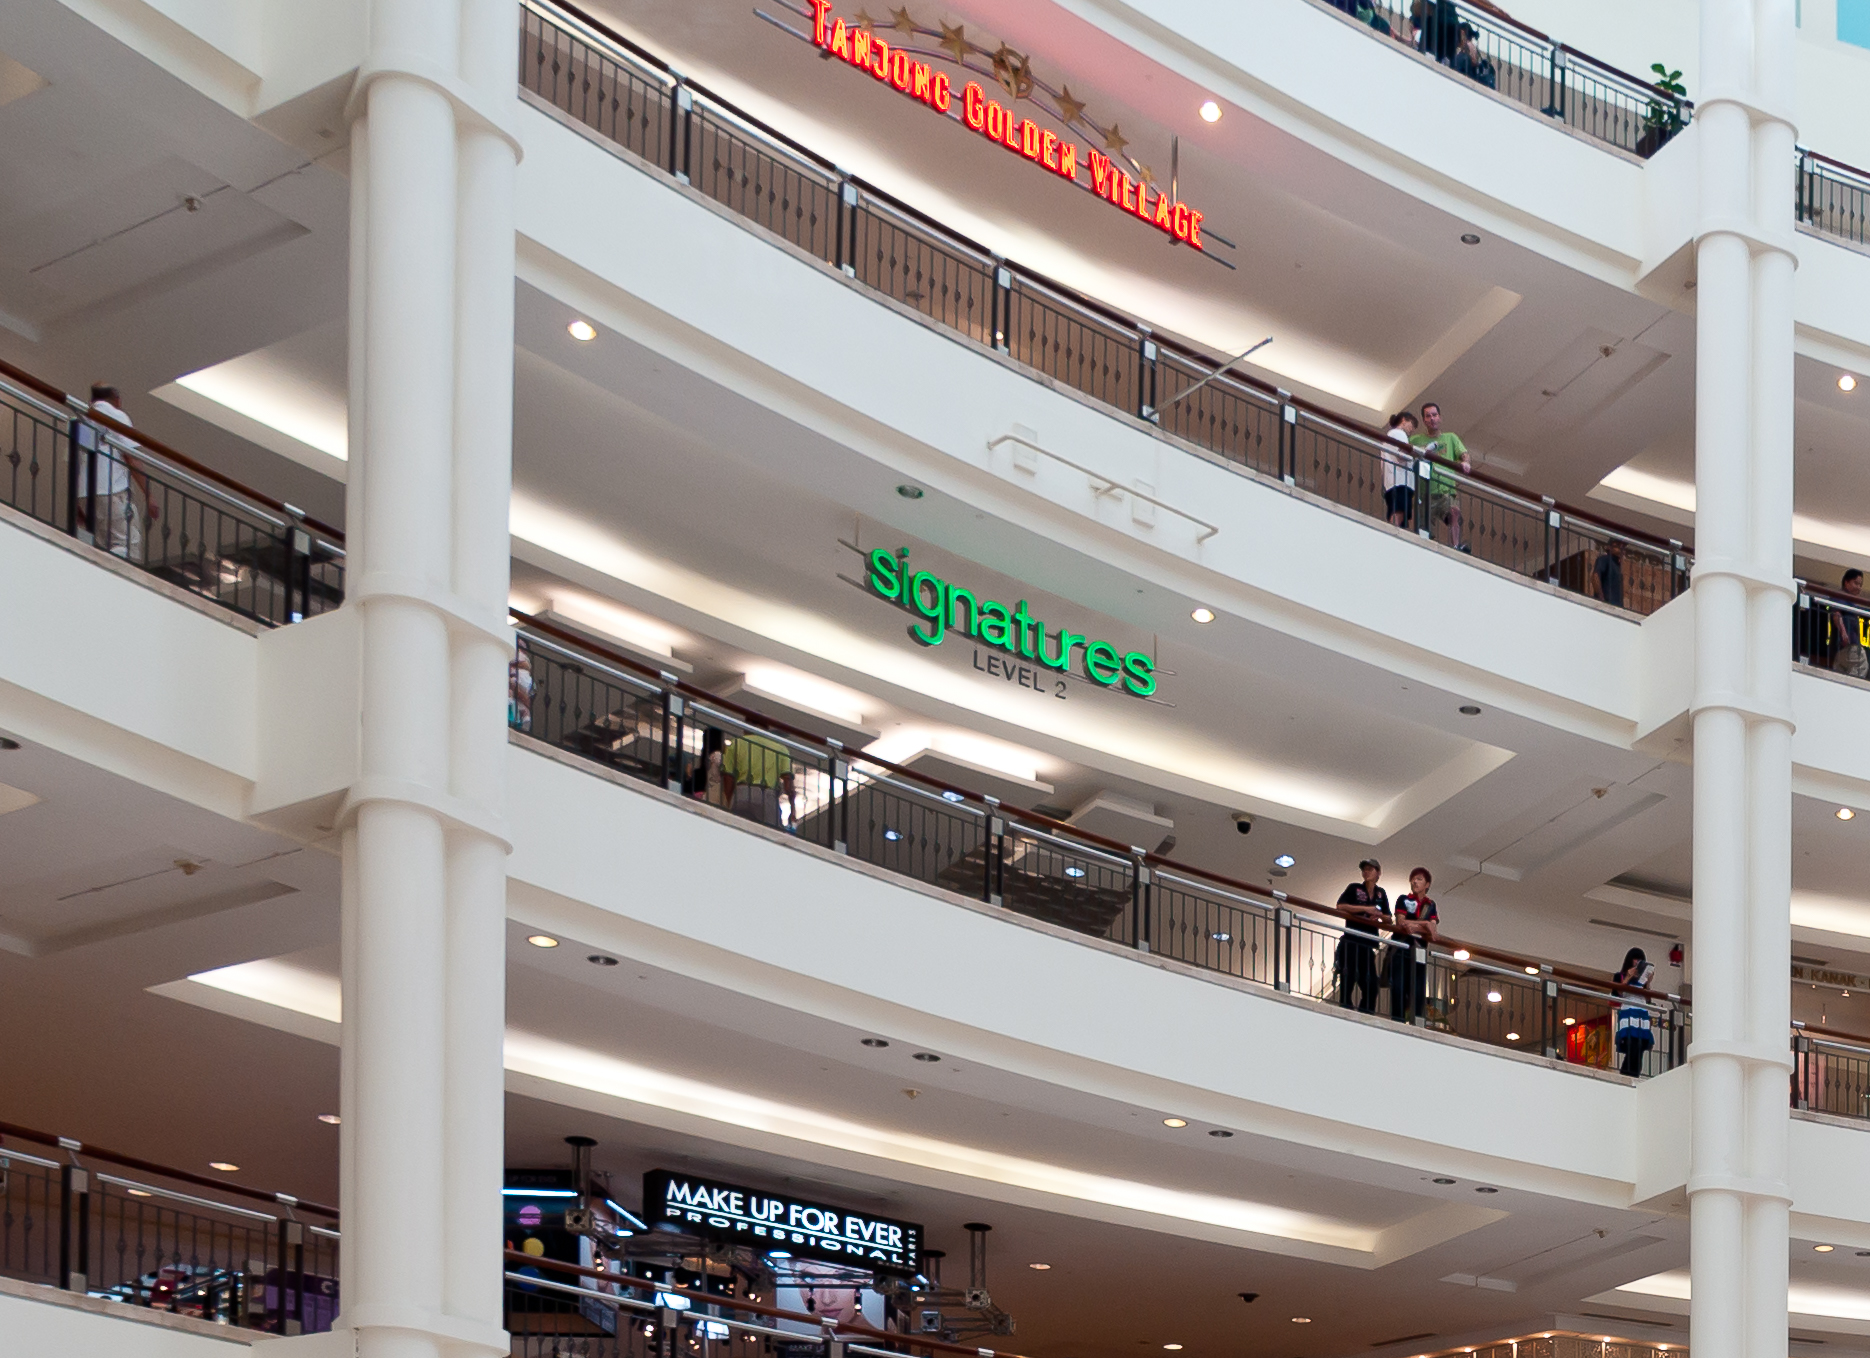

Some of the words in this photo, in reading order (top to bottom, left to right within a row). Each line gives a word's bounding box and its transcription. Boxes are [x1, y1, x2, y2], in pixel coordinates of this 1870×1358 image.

[808, 0, 951, 114] TANJONG
[963, 80, 1077, 180] GOLDEN
[1088, 148, 1204, 249] VILLAGE
[870, 547, 1157, 696] signatures
[973, 650, 1046, 693] LEVEL
[1054, 680, 1067, 700] 2
[666, 1179, 744, 1215] MAKE
[750, 1196, 784, 1222] UP
[789, 1204, 839, 1236] FOR
[845, 1216, 903, 1248] EVER
[666, 1207, 904, 1264] PROFESSIONAL
